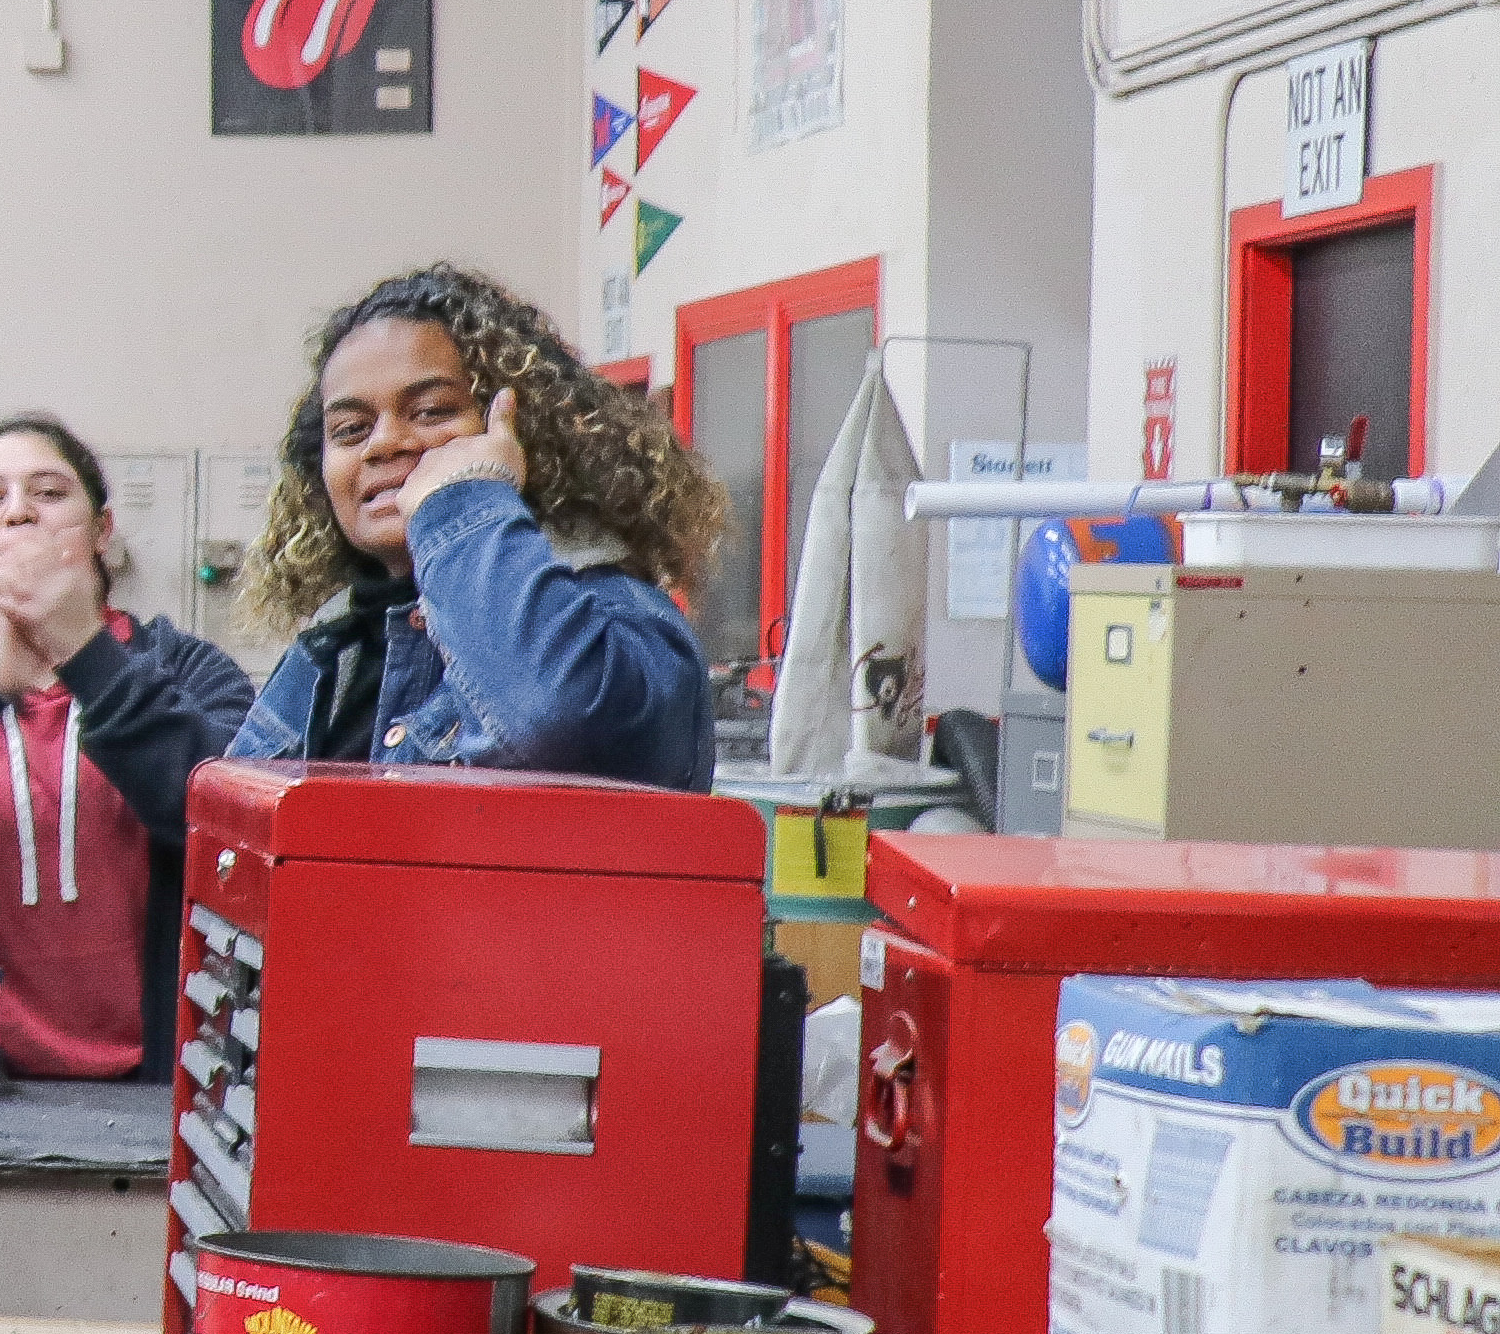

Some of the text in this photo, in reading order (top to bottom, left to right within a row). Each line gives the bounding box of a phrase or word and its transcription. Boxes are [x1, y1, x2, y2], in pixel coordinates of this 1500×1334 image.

[1287, 54, 1364, 133] NOT AN
[1300, 130, 1347, 198] EXIT
[1337, 1072, 1485, 1114] Quick
[1342, 1122, 1474, 1160] Build
